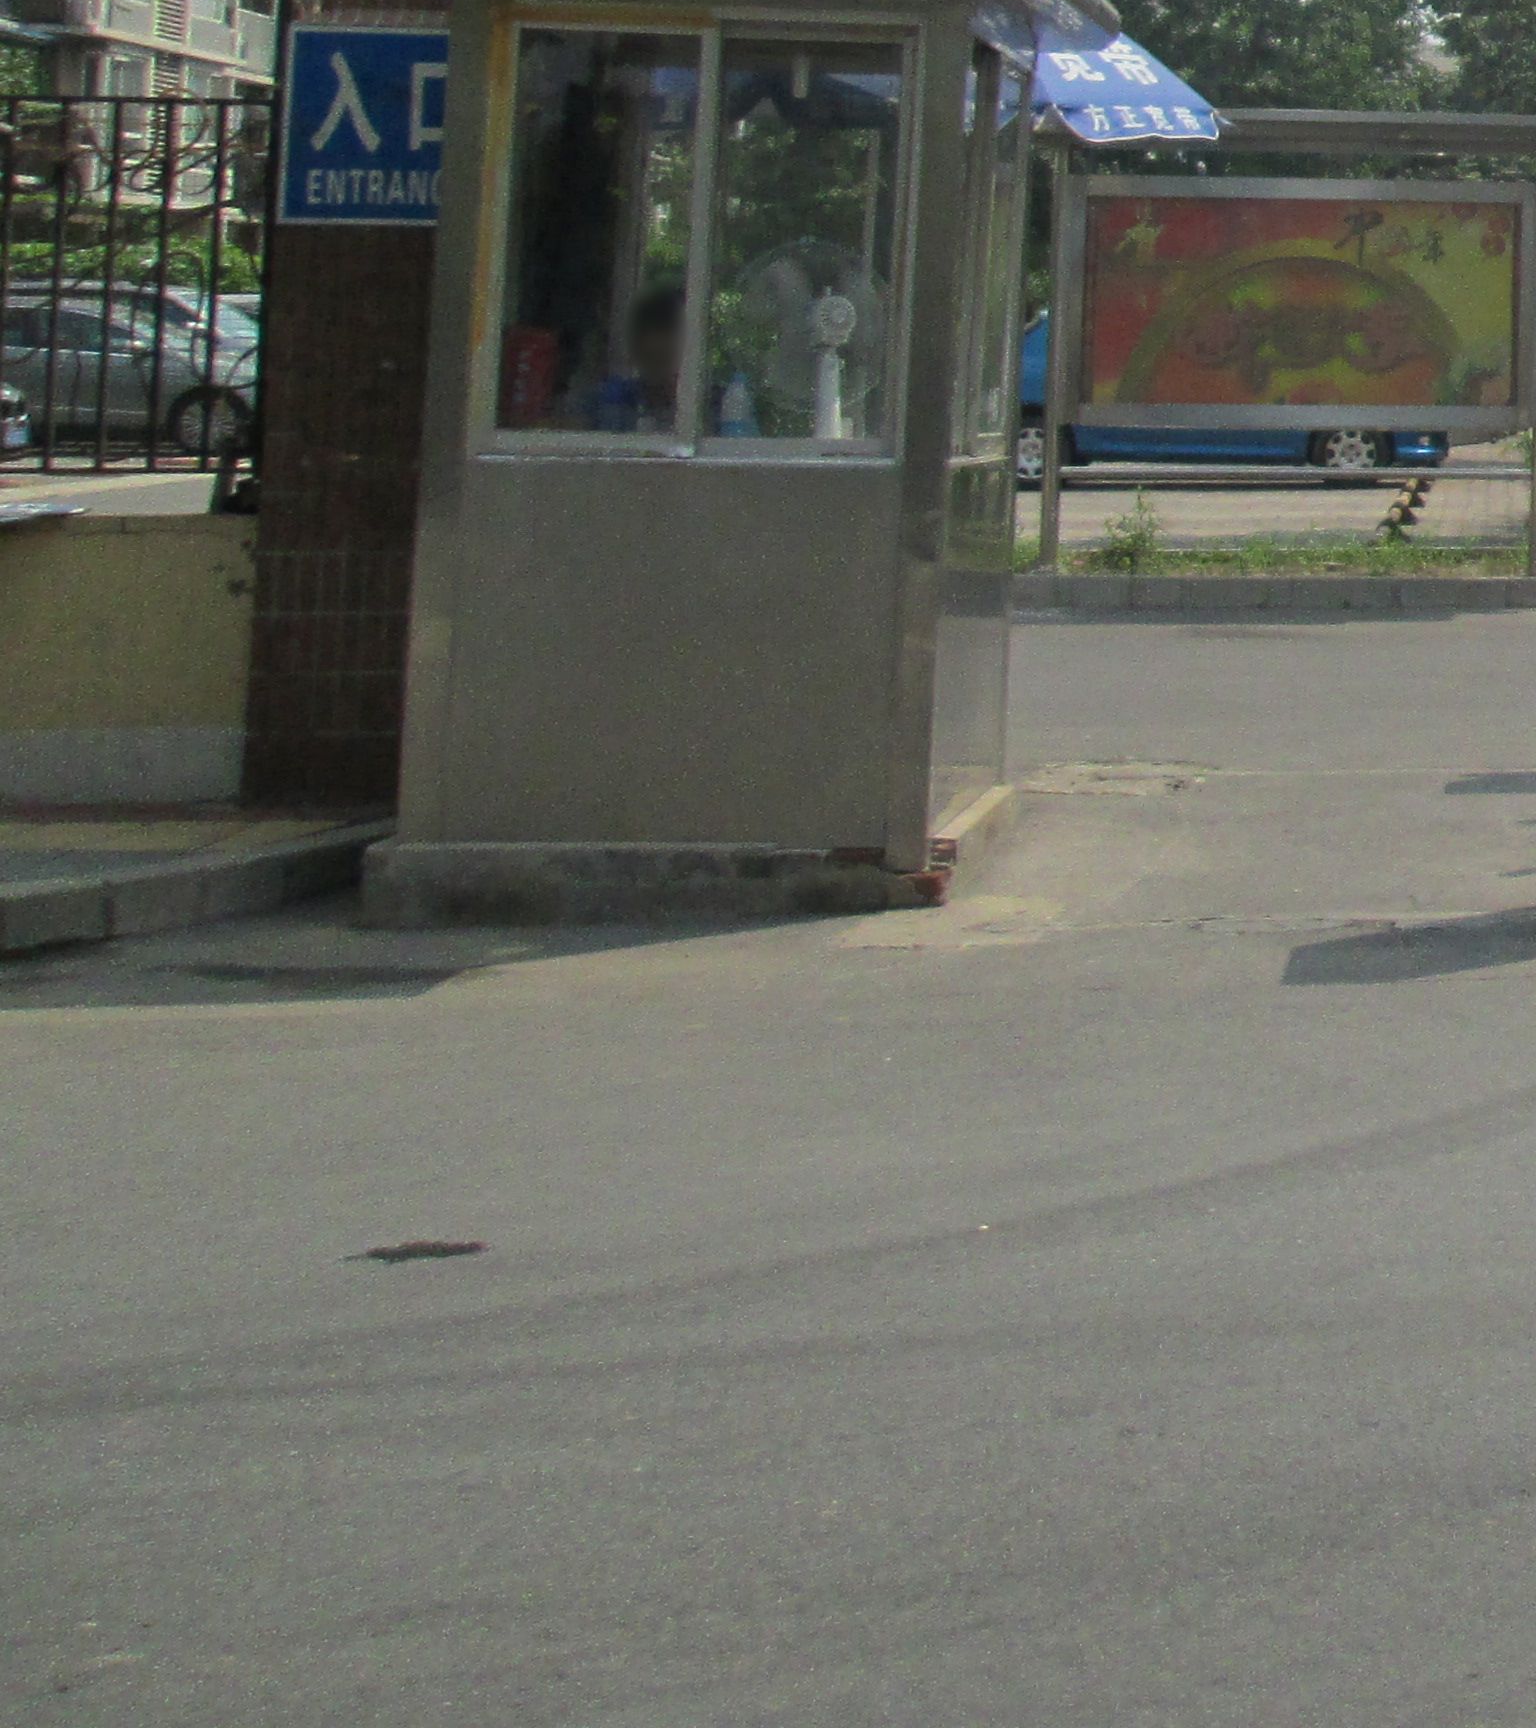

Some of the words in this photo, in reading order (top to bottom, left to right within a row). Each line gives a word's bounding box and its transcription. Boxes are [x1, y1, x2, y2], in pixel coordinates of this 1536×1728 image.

[1083, 104, 1201, 132] 方正宽带
[307, 168, 441, 205] ENTRANC
